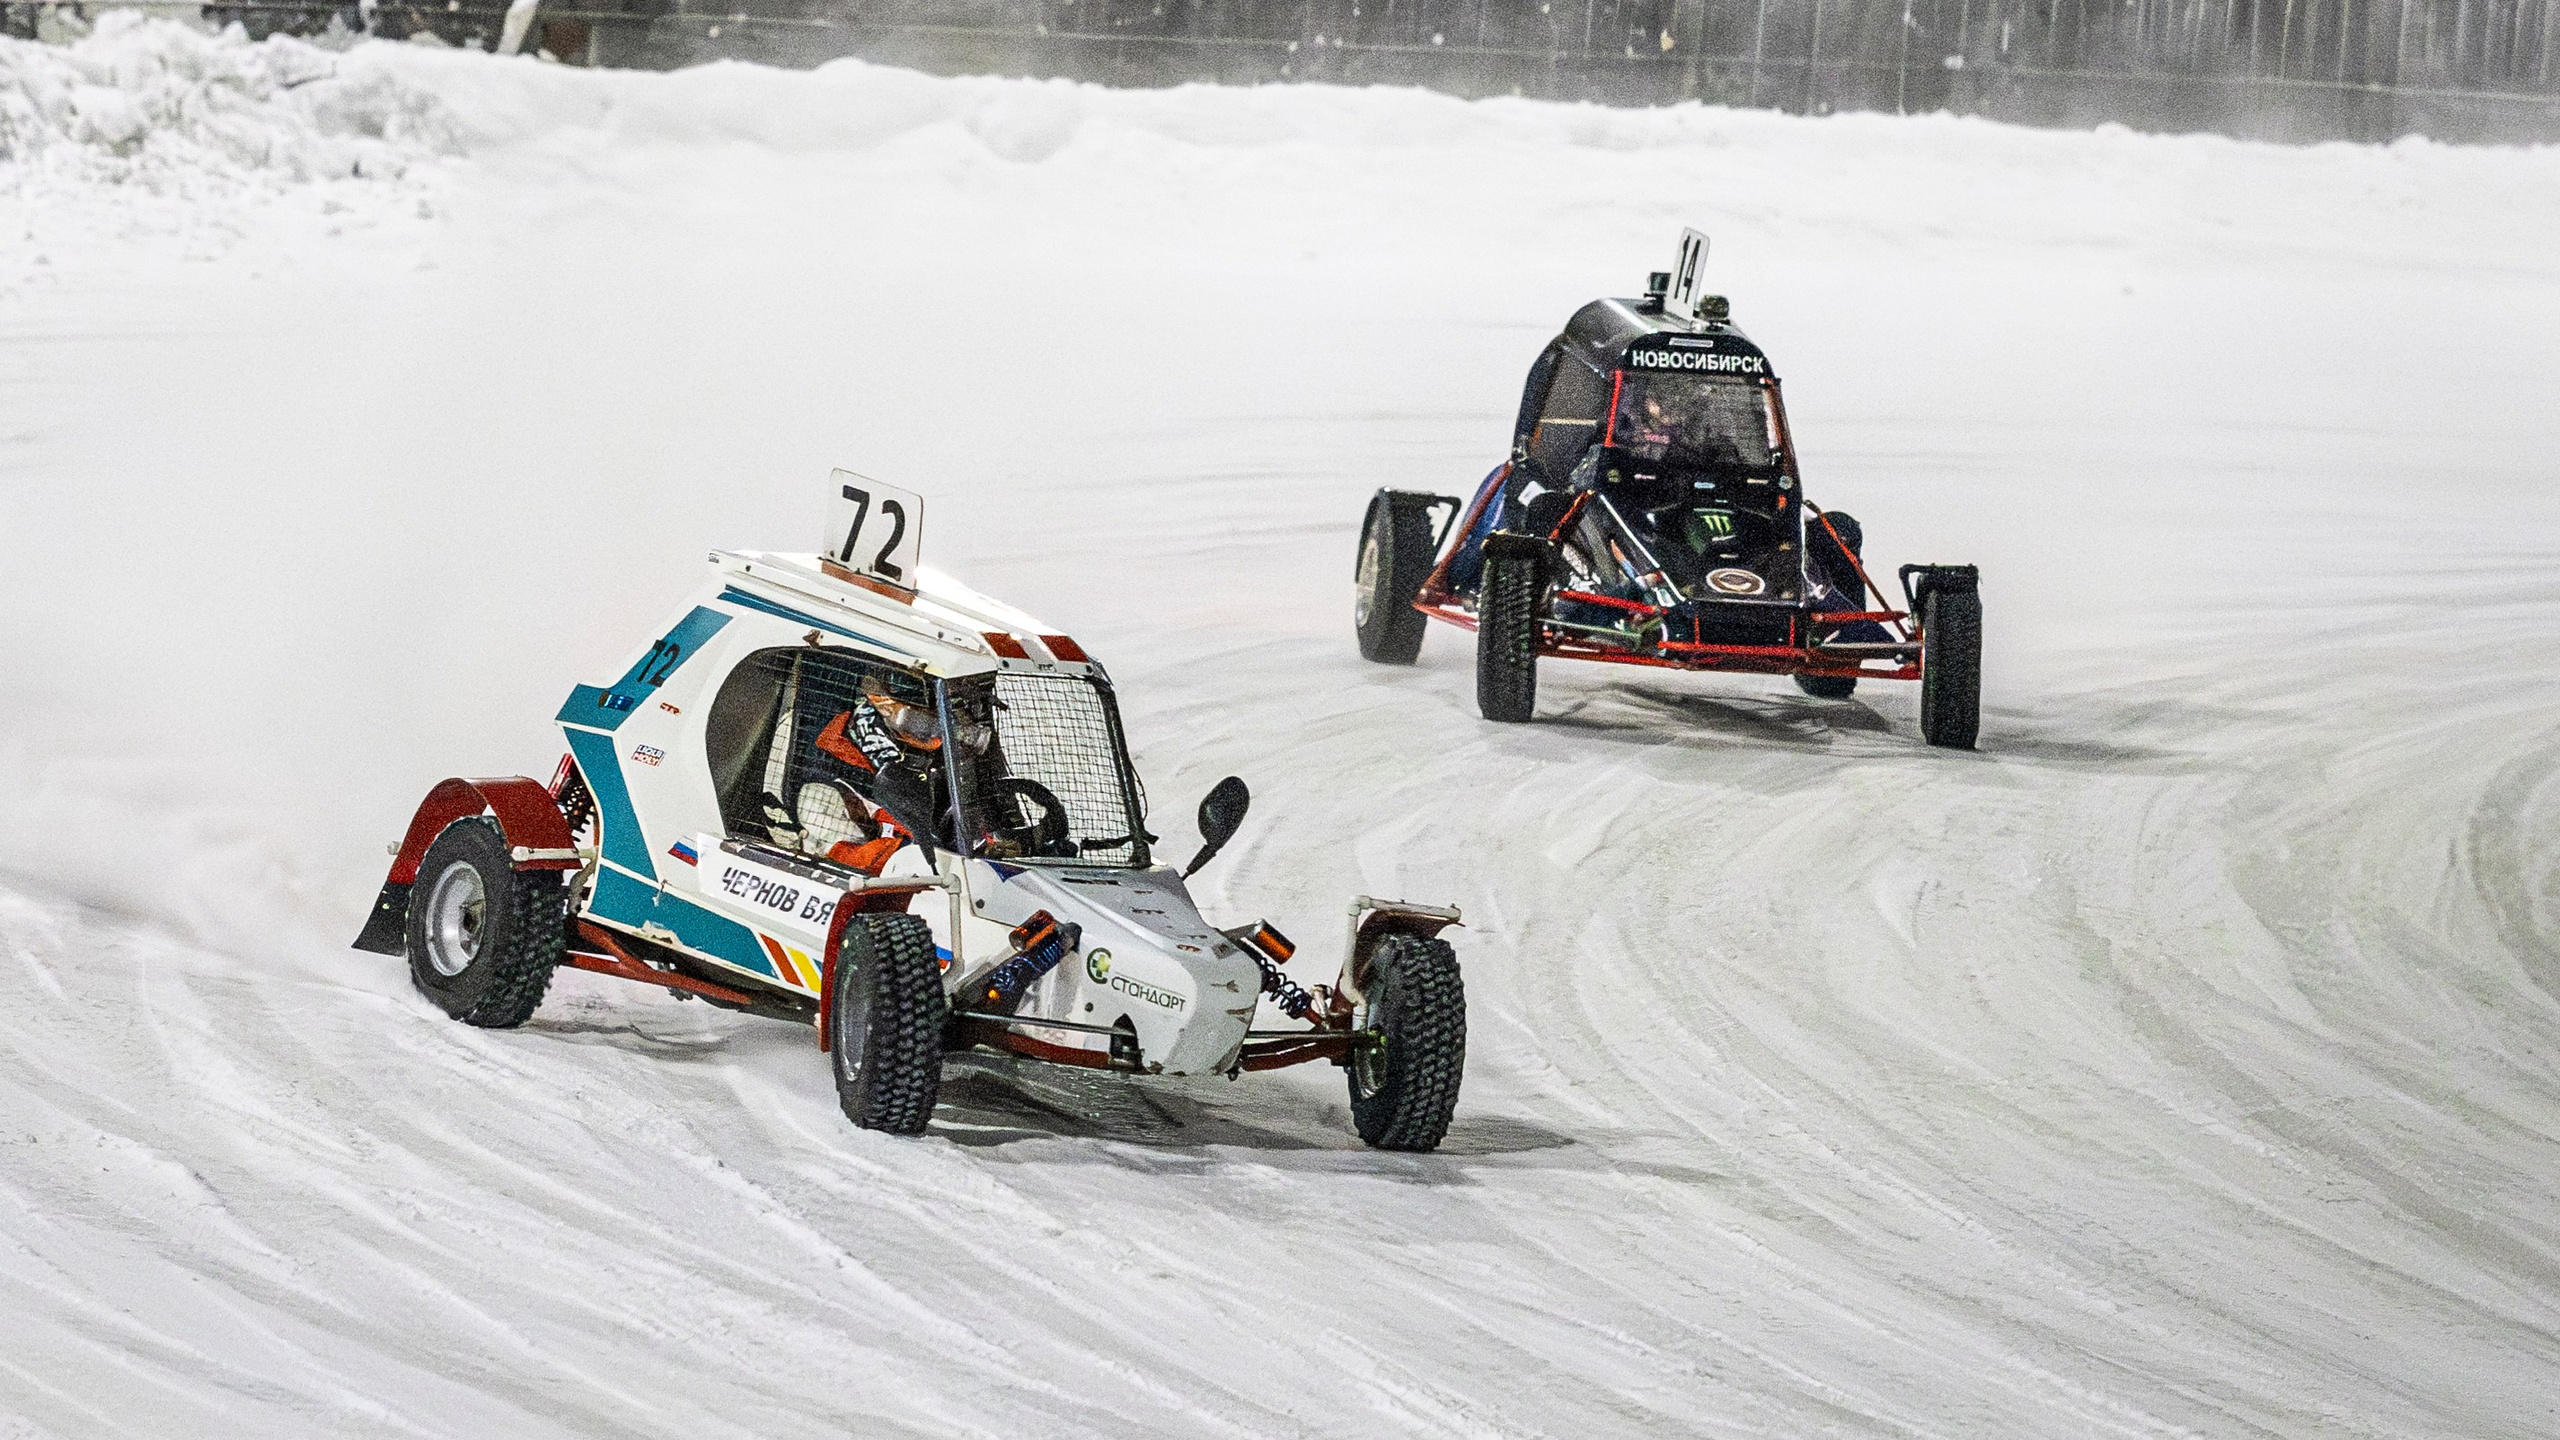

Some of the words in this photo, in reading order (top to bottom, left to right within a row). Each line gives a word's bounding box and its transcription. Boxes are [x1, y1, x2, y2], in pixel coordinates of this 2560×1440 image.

[1673, 234, 1701, 303] 14
[1631, 350, 1764, 373] НОВОСИБИРСК
[840, 484, 905, 582] 72
[636, 639, 680, 688] 72
[721, 867, 800, 912] ЧЕРНОВ
